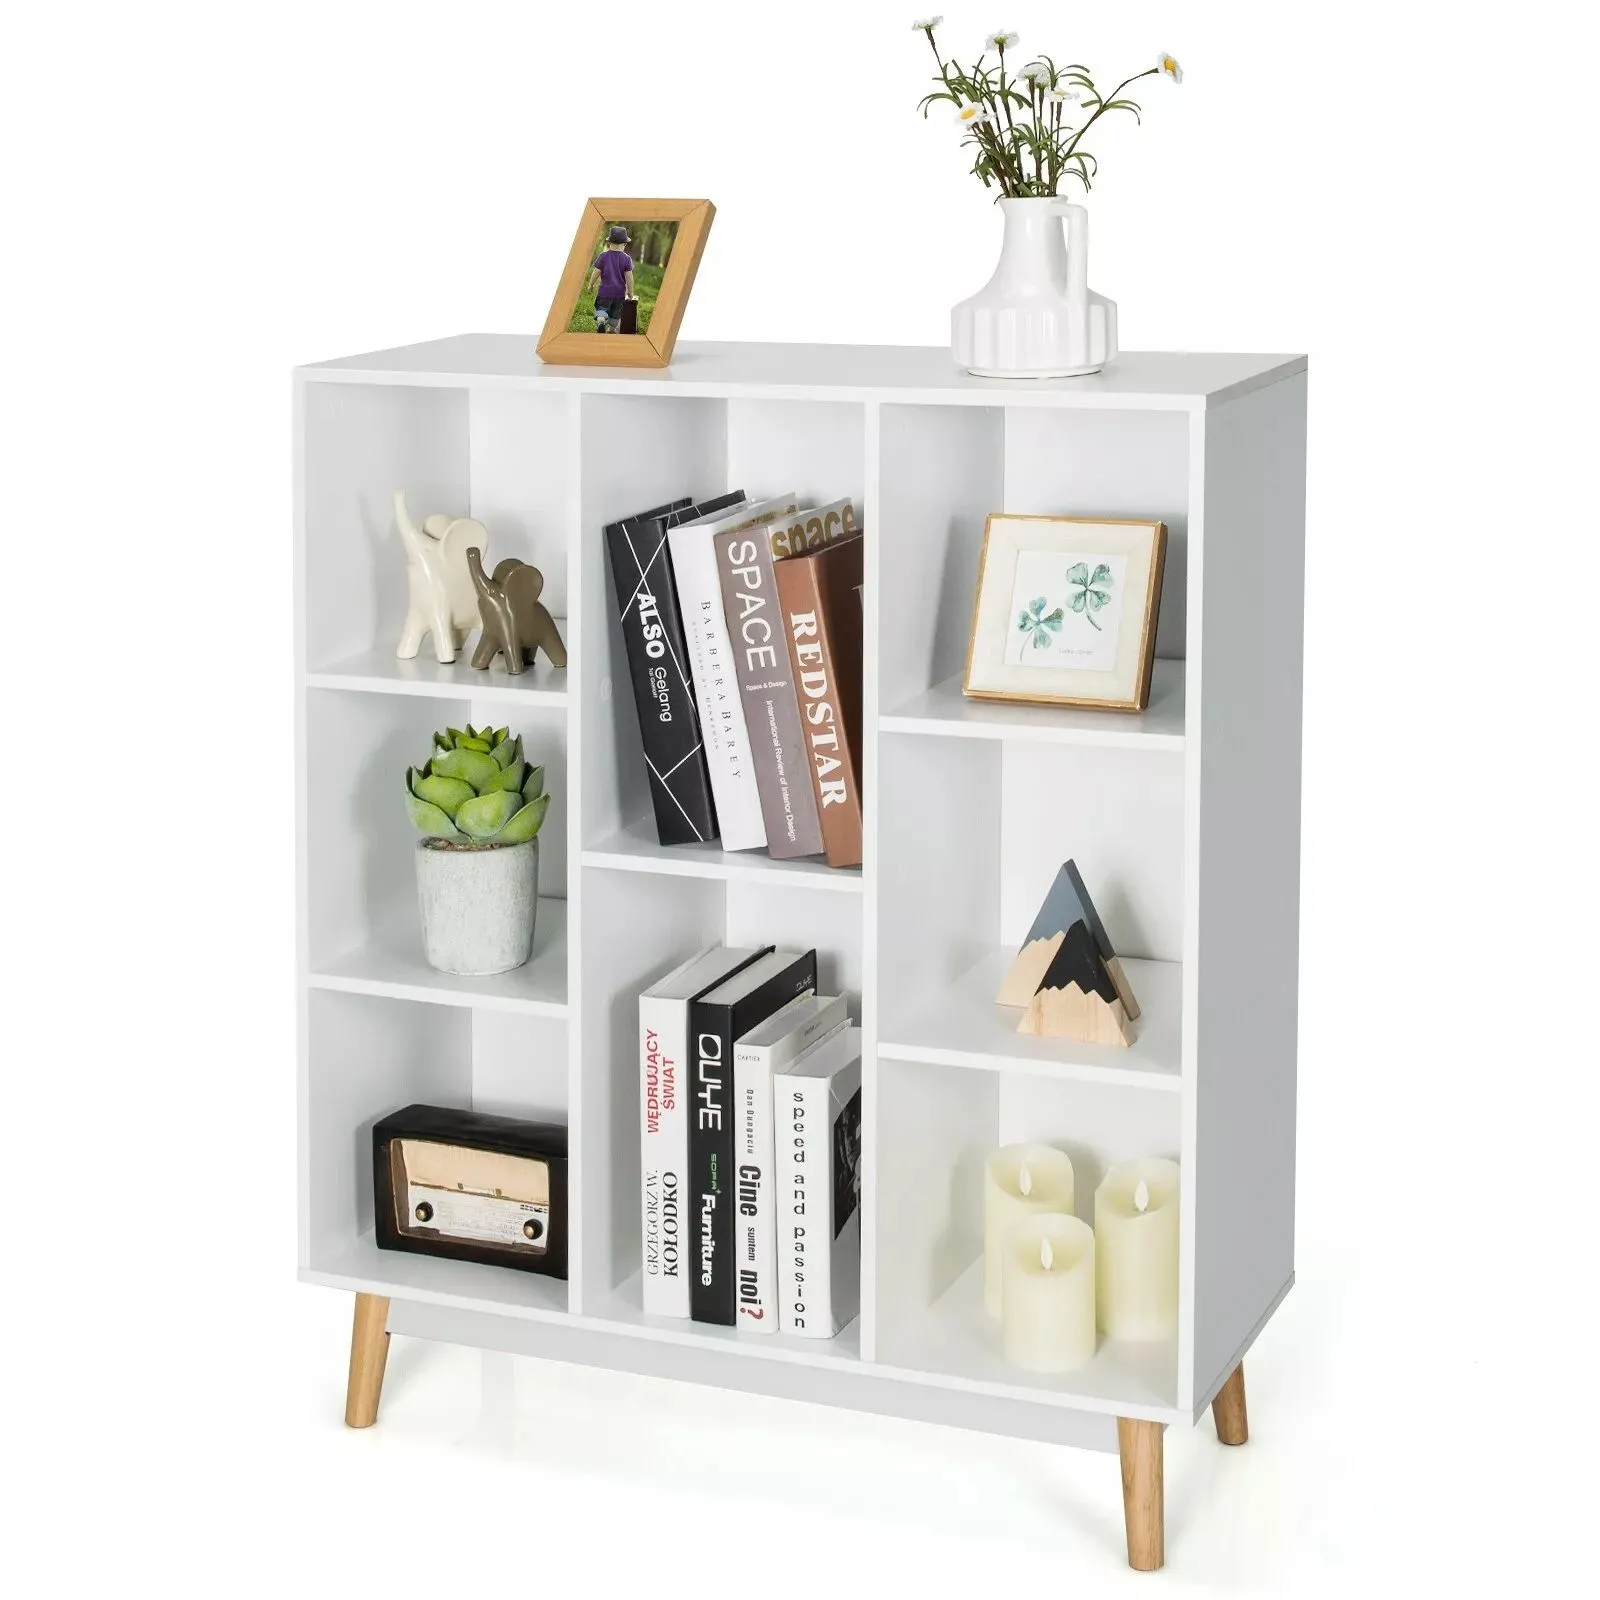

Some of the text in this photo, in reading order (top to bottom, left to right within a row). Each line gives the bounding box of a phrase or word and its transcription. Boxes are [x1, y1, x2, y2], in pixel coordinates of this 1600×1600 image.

[637, 593, 672, 722] ALSO Gelang
[727, 540, 777, 672] SPACE
[701, 601, 741, 778] BARBERA BAREY
[746, 682, 762, 691] Space
[768, 680, 787, 688] Design
[790, 609, 848, 808] REDSTAR
[766, 700, 796, 841] International Review of Interior Design
[647, 1028, 661, 1133] WĘDRUJĄCY
[660, 1057, 675, 1110] ŚWIAT
[698, 1034, 722, 1131] OUYE
[646, 1191, 658, 1275] GRZEGORZ
[662, 1171, 678, 1277] KOŁODKO
[701, 1193, 716, 1287] Furniture
[739, 1165, 764, 1320] Cine suntem noi?
[793, 1092, 806, 1329] speed and passion
